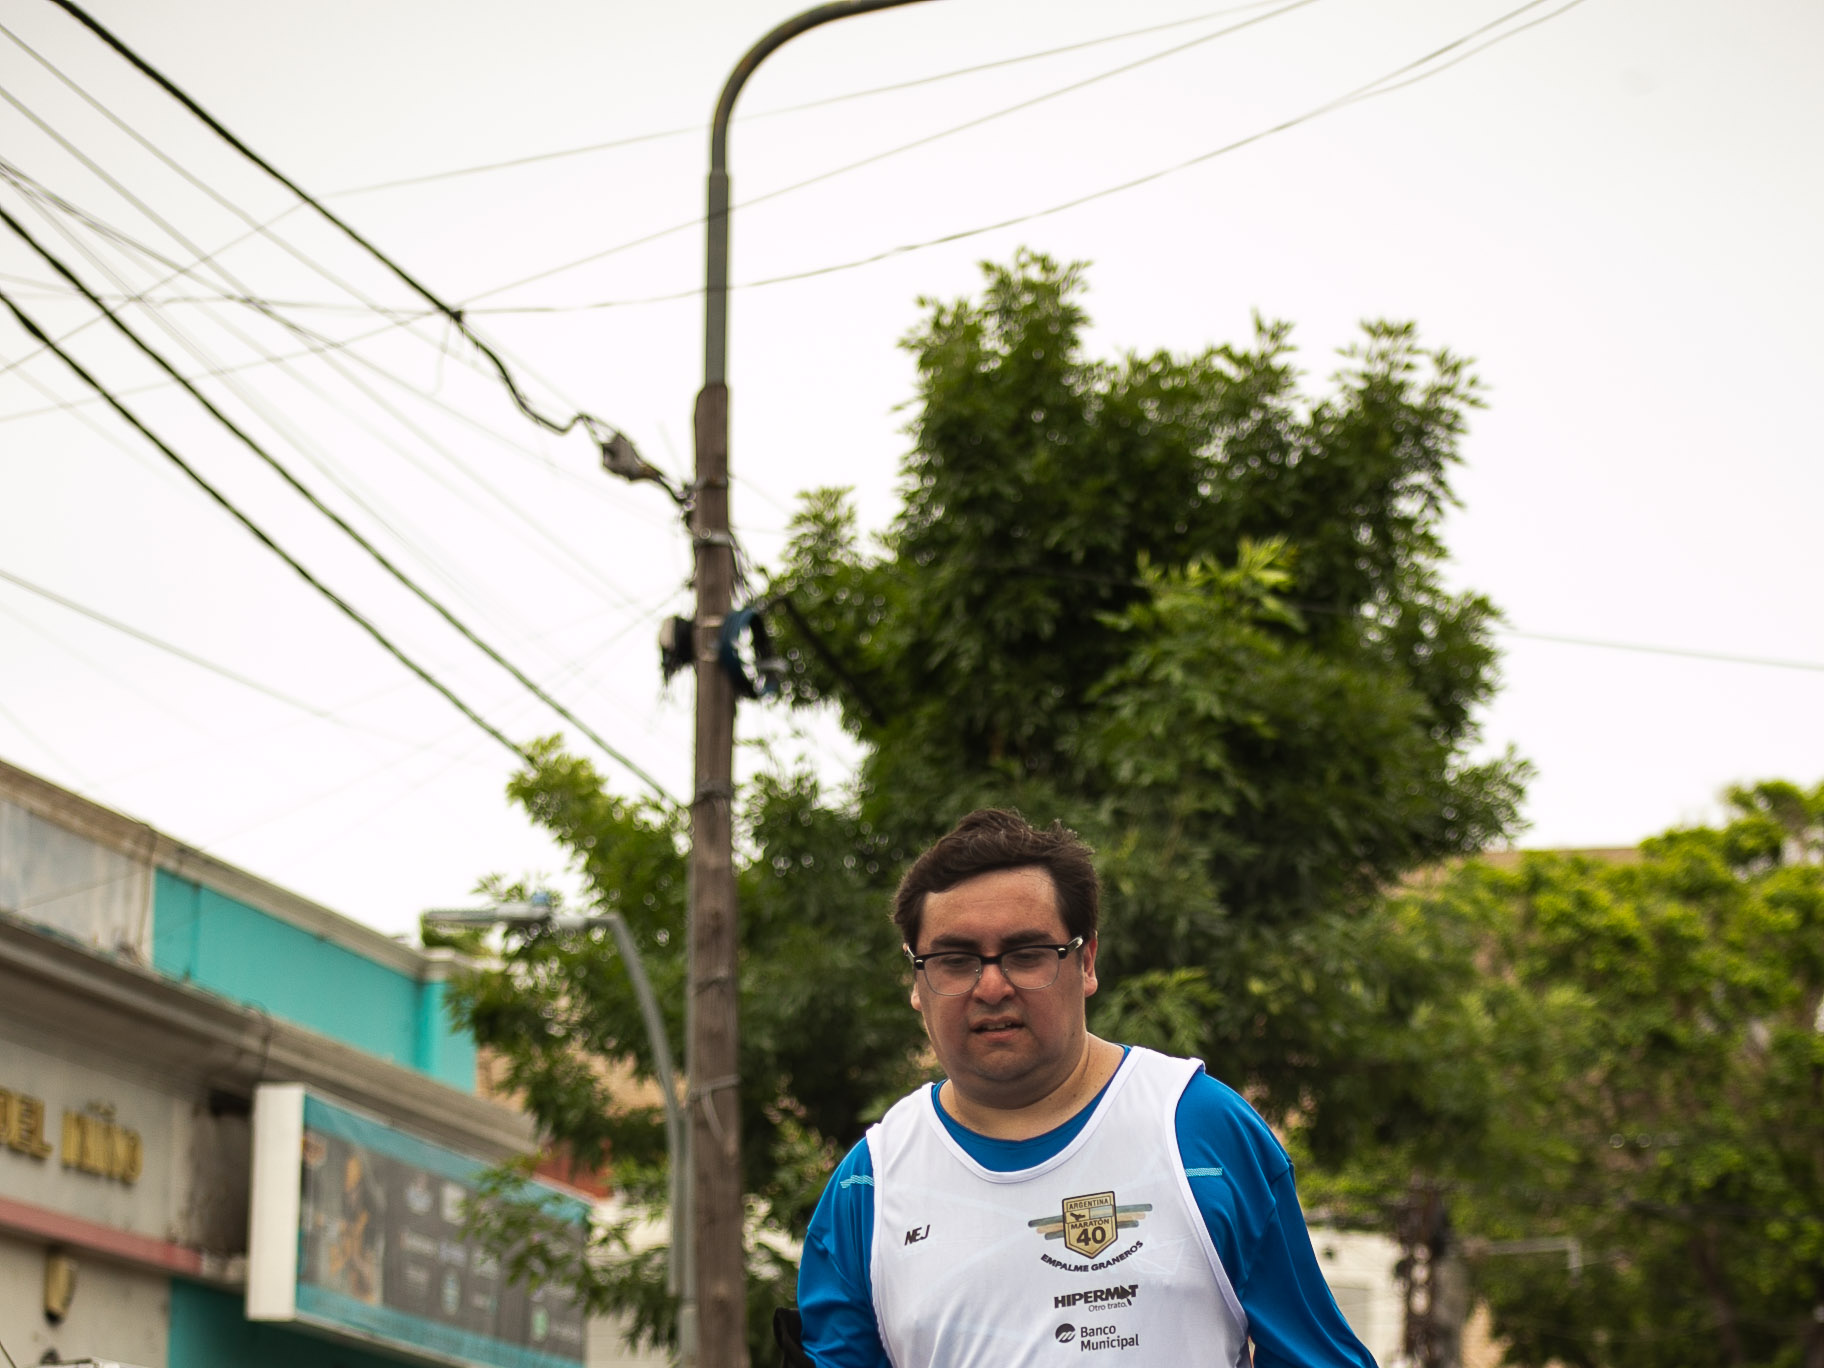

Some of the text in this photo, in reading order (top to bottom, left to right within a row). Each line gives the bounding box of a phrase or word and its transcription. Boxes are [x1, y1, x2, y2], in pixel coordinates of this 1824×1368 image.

[1069, 1198, 1109, 1210] ARGENTINA
[904, 1224, 931, 1246] NEJ
[1076, 1226, 1107, 1246] 40
[1040, 1240, 1144, 1272] EMPALME GRANEROS
[1054, 1284, 1139, 1309] HIPERMAT
[1088, 1304, 1106, 1312] Otro
[1080, 1325, 1117, 1338] Banco
[1080, 1333, 1140, 1352] Municipal
